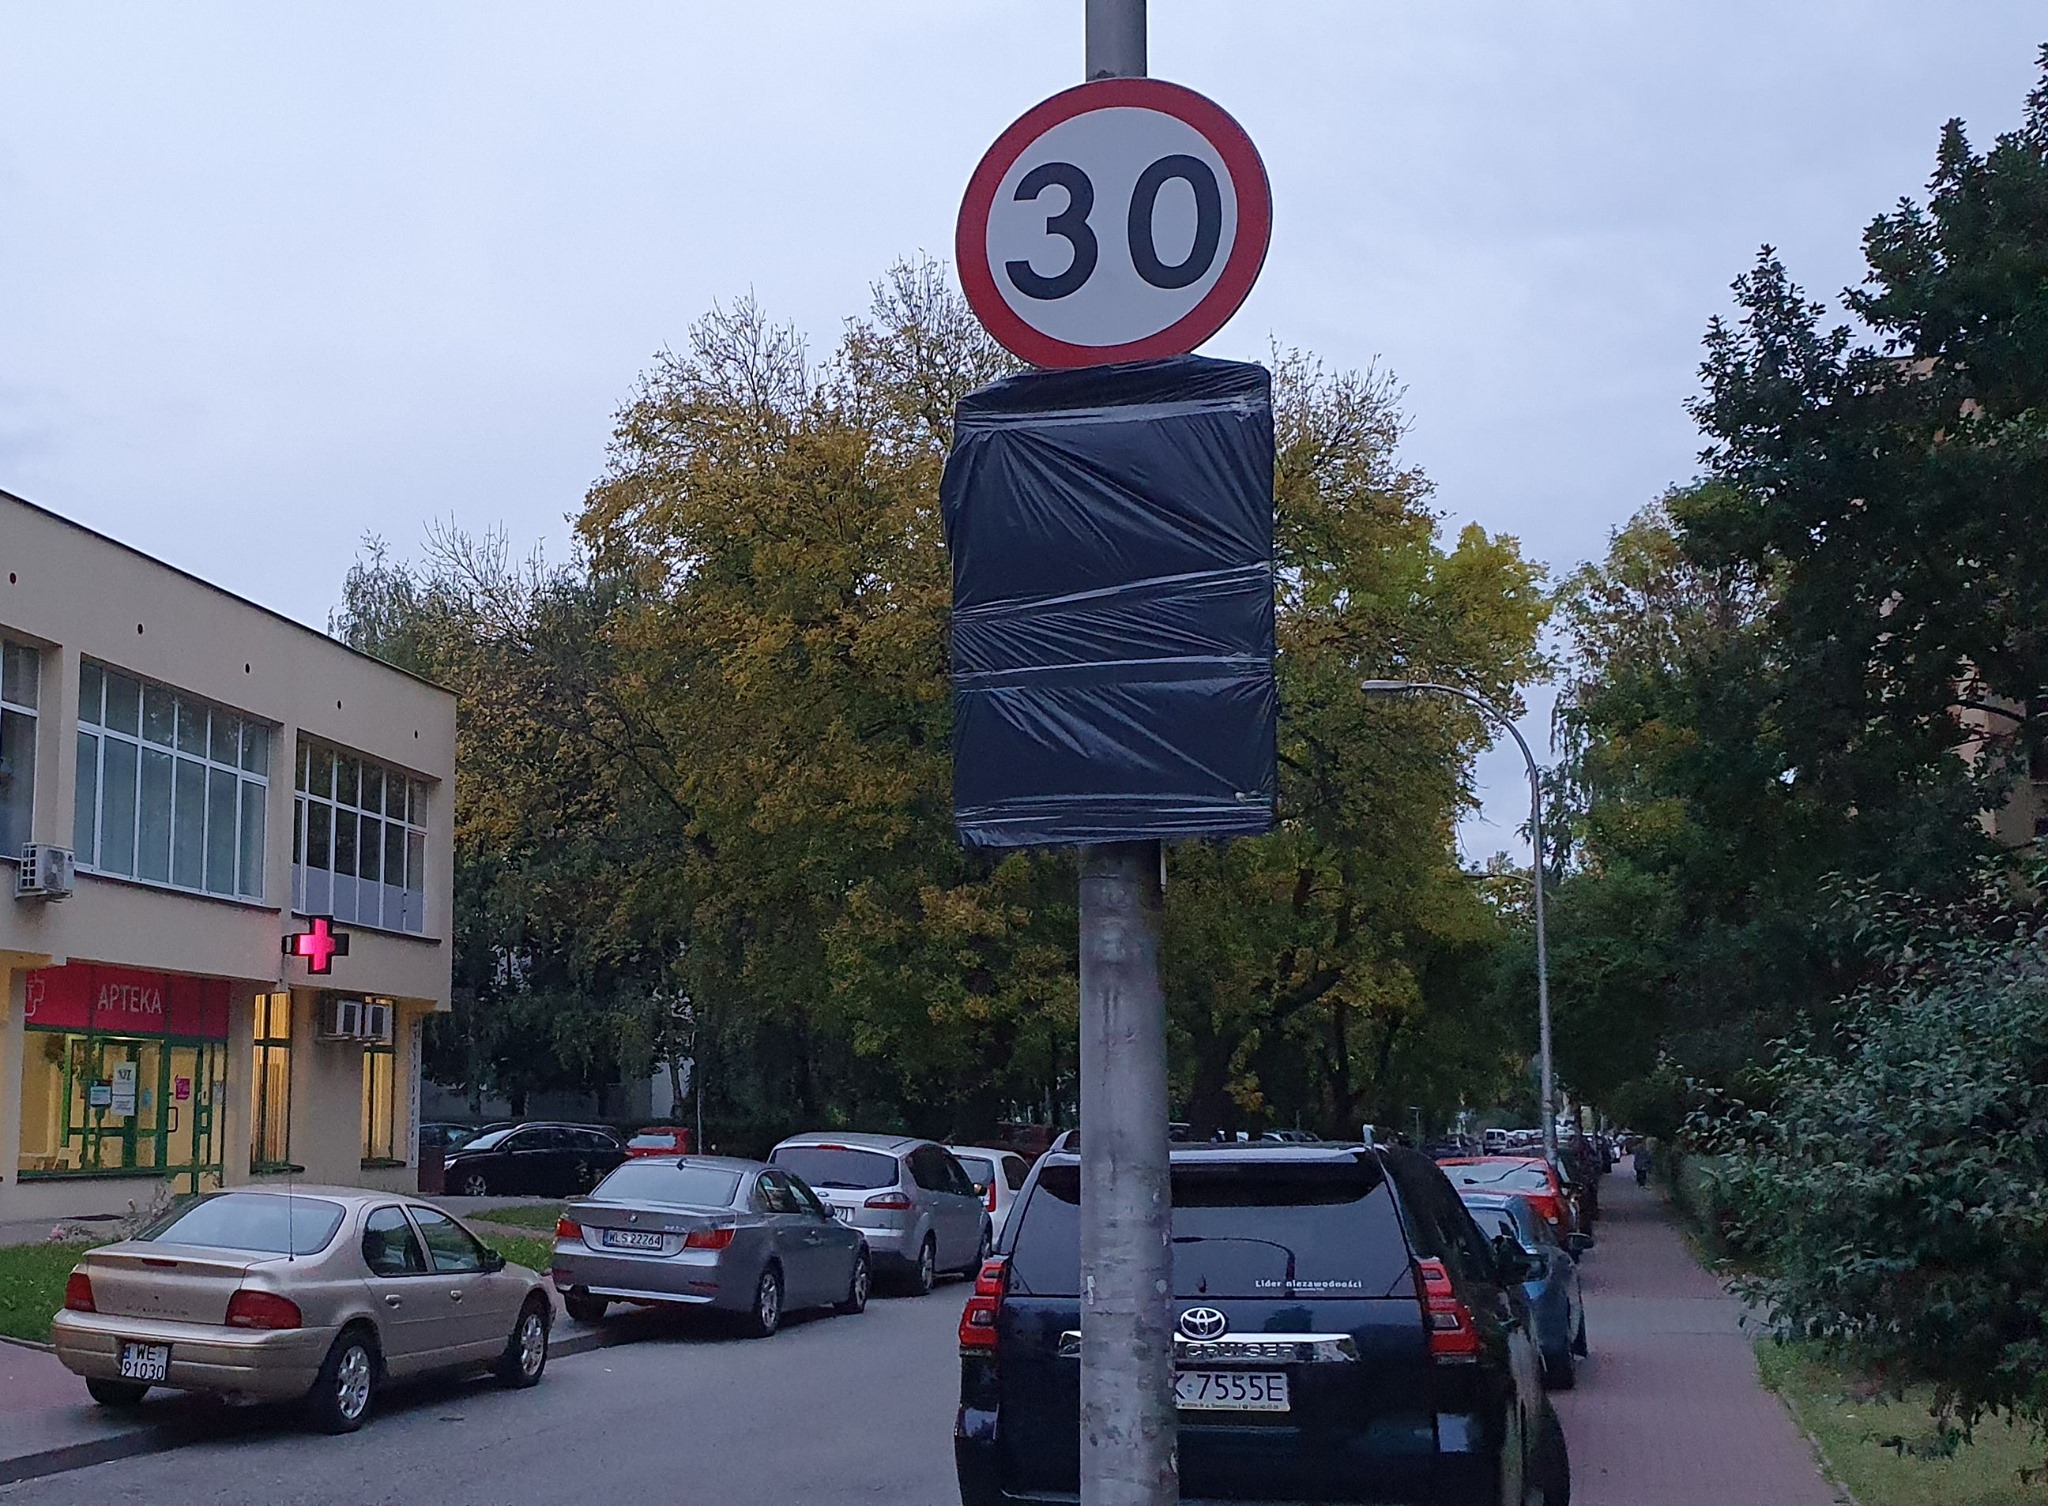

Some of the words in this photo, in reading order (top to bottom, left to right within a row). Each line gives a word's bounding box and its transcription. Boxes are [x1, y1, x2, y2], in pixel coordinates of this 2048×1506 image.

[1005, 153, 1223, 300] 30
[97, 983, 163, 1015] APTEKA
[609, 1231, 628, 1243] WLS
[630, 1233, 661, 1246] 22264
[1255, 1279, 1282, 1288] Lider
[137, 1345, 157, 1361] WE
[124, 1361, 165, 1380] 91030
[1196, 1373, 1284, 1402] 7555E
